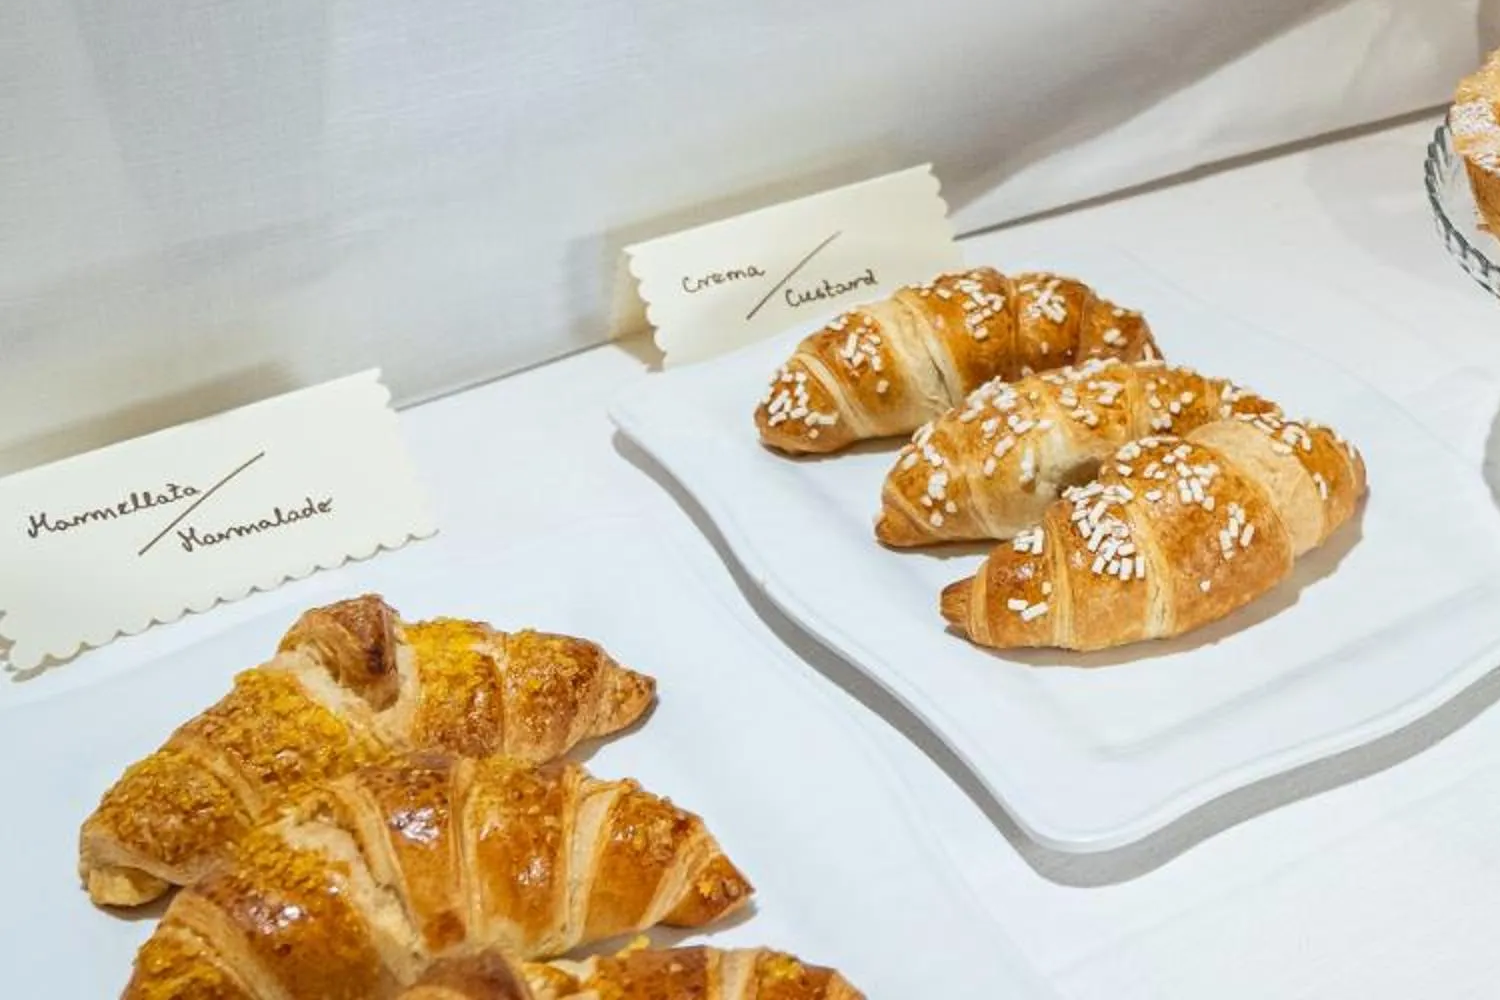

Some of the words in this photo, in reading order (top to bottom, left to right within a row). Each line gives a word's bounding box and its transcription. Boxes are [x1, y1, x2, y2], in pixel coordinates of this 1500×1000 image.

[680, 262, 768, 294] Crema
[784, 267, 880, 308] Custard
[26, 482, 203, 540] Marmellata
[175, 495, 335, 554] Marmalade
